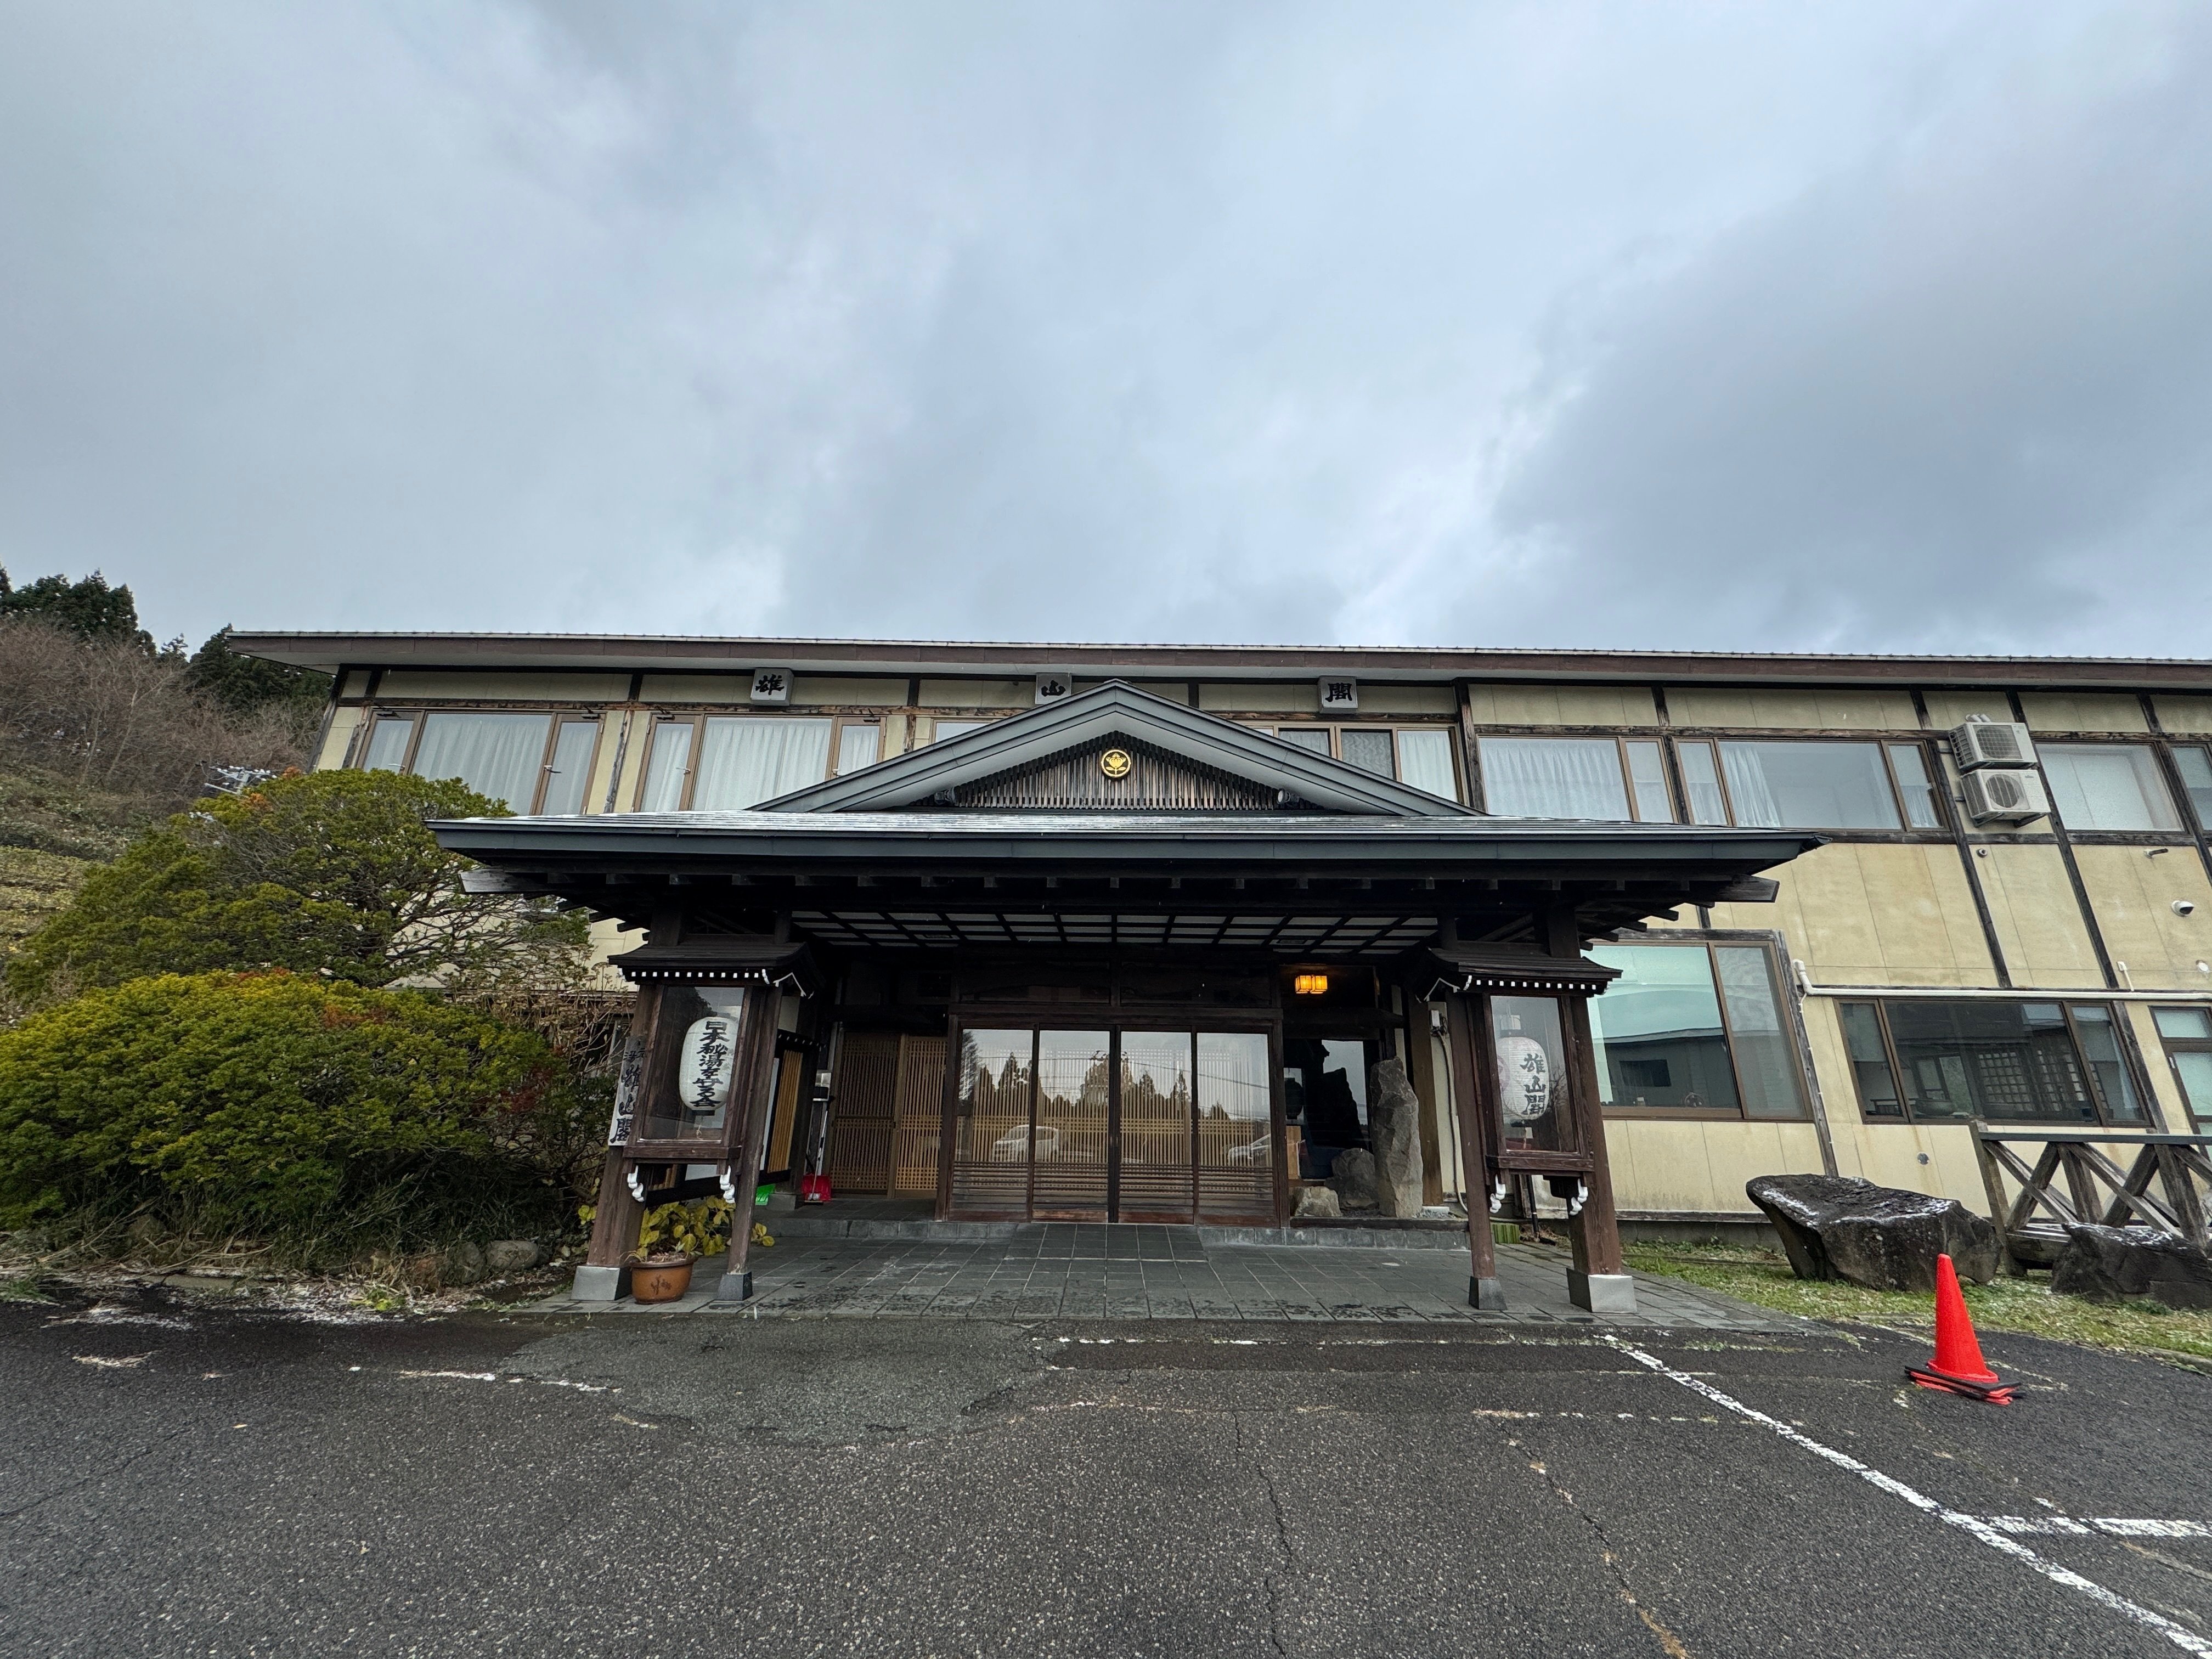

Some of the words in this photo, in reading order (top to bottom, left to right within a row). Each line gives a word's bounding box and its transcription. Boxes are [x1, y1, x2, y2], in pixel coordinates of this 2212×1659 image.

[755, 674, 785, 695] 雄
[1041, 680, 1066, 697] 山
[1325, 682, 1352, 702] 閣
[1520, 1053, 1546, 1115] 雄山閣
